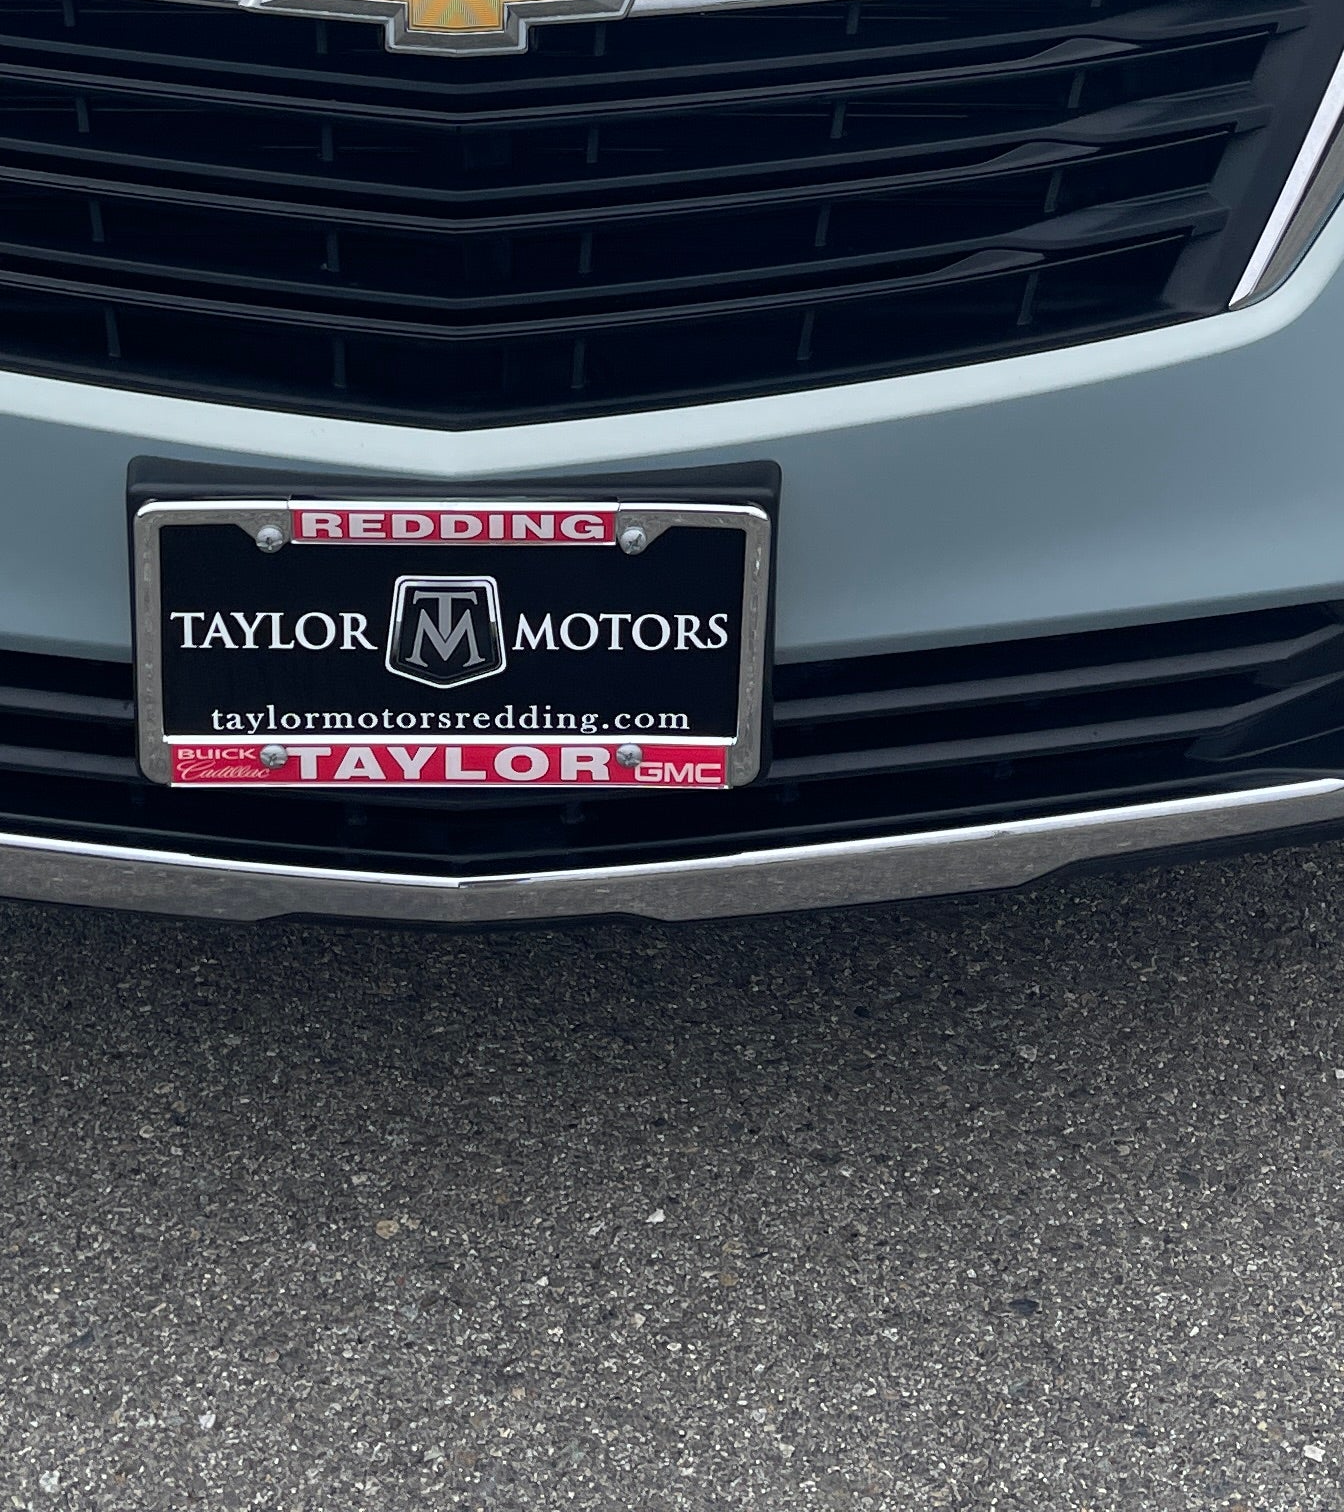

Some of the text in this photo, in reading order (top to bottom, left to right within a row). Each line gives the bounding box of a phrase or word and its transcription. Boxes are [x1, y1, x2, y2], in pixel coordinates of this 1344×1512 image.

[300, 511, 605, 539] REDDING
[169, 611, 379, 650] TAYLOR
[512, 612, 729, 651] MOTORS
[211, 704, 691, 735] taylormotorsredding.com
[176, 759, 271, 781] Cadillac
[177, 744, 722, 784] BUICK TAYLOR GMC
